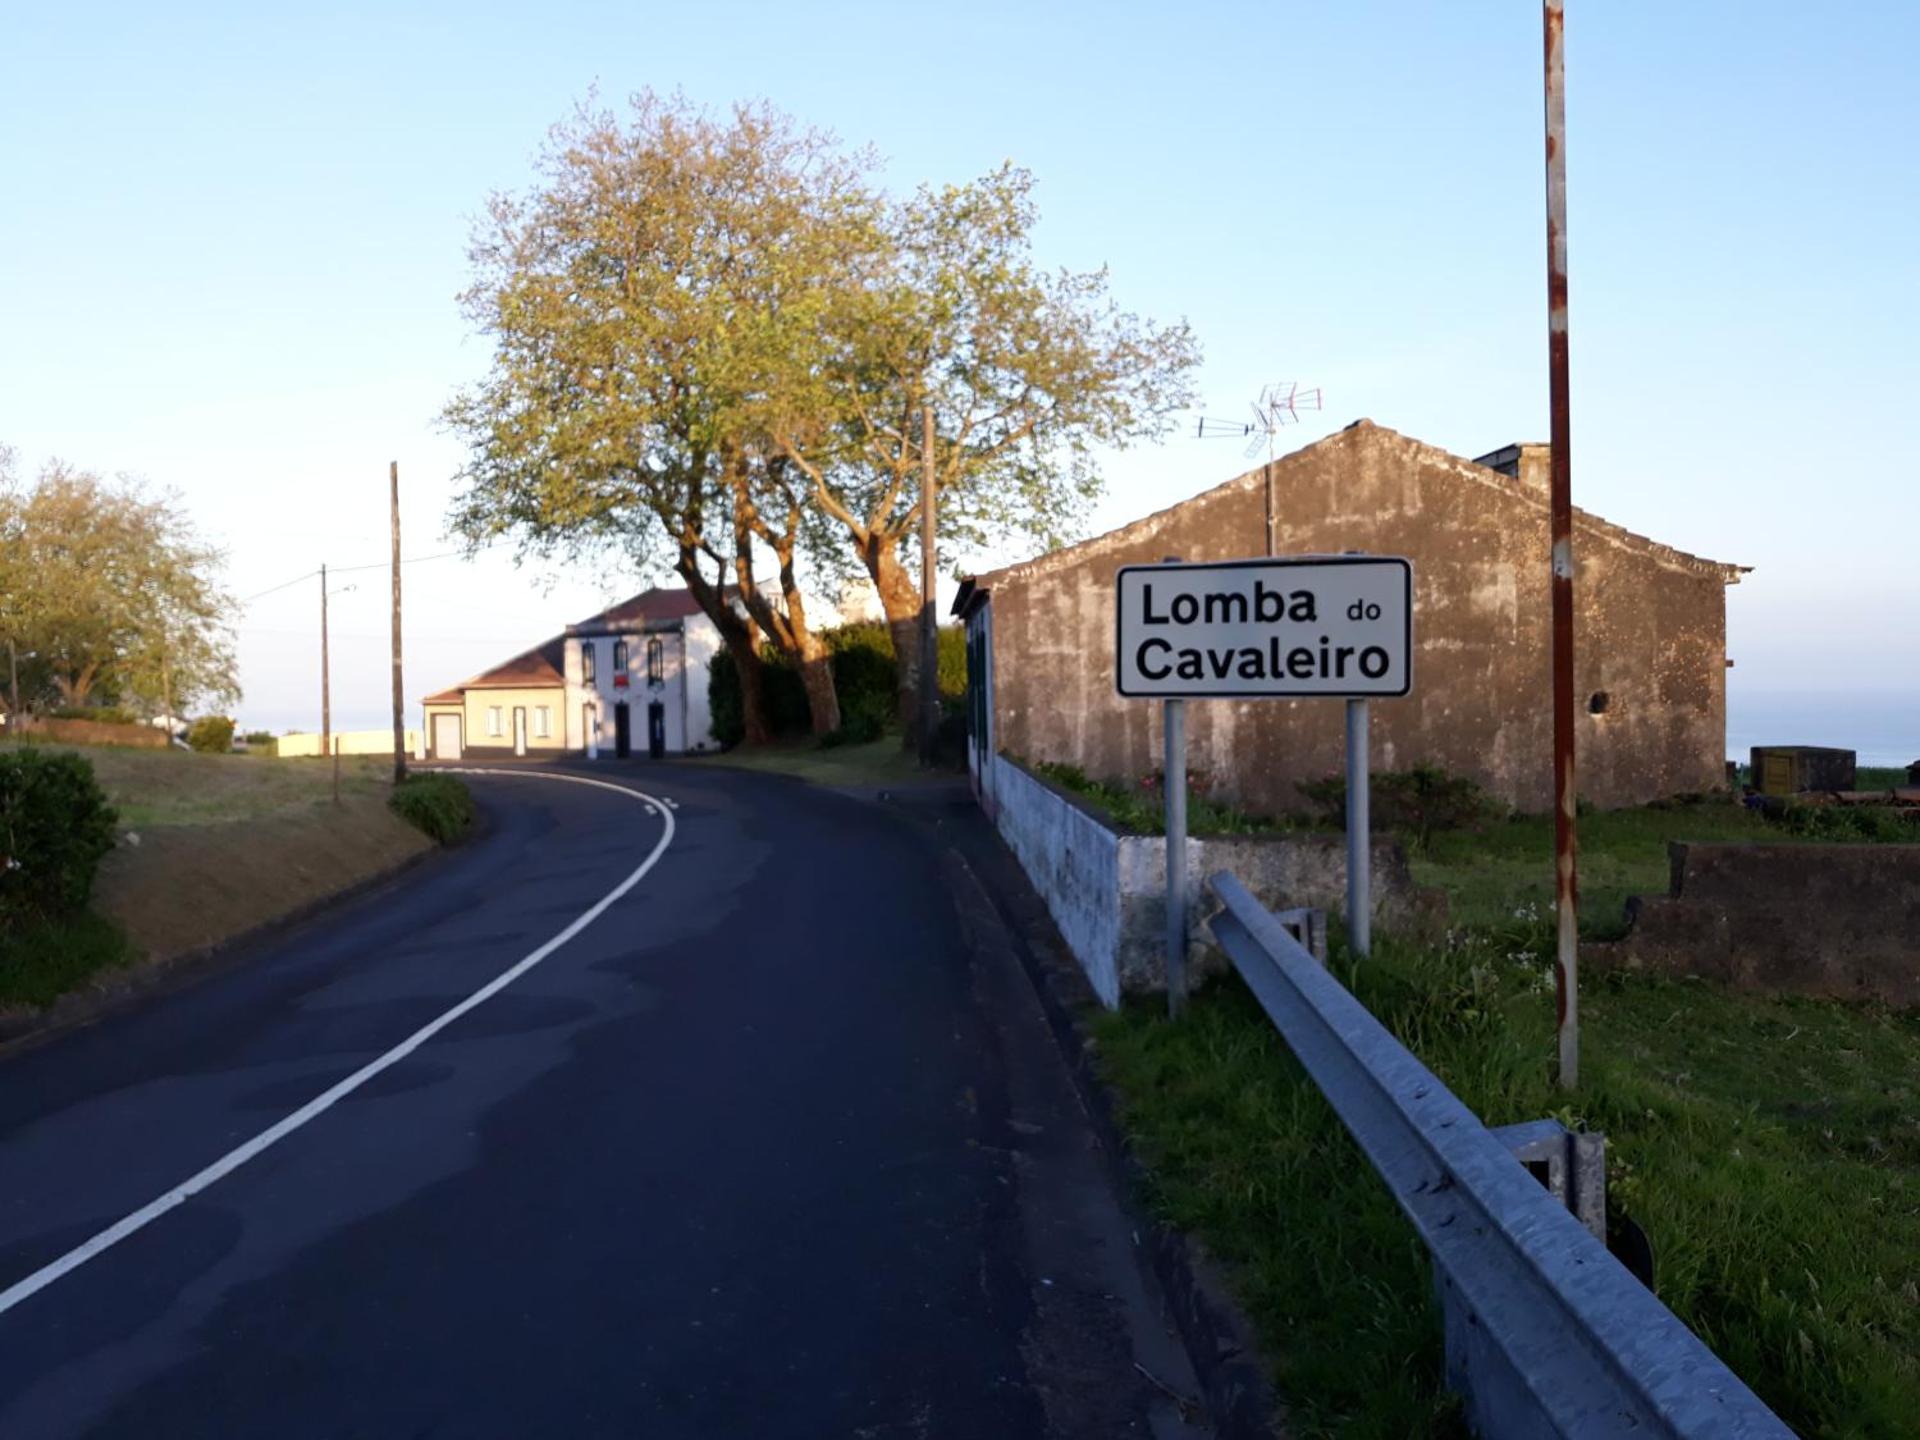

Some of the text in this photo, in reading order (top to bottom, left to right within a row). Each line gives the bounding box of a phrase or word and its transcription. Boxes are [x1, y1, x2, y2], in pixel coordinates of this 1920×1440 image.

[1143, 580, 1381, 625] Lomba do
[1136, 635, 1389, 680] Cavaleiro
